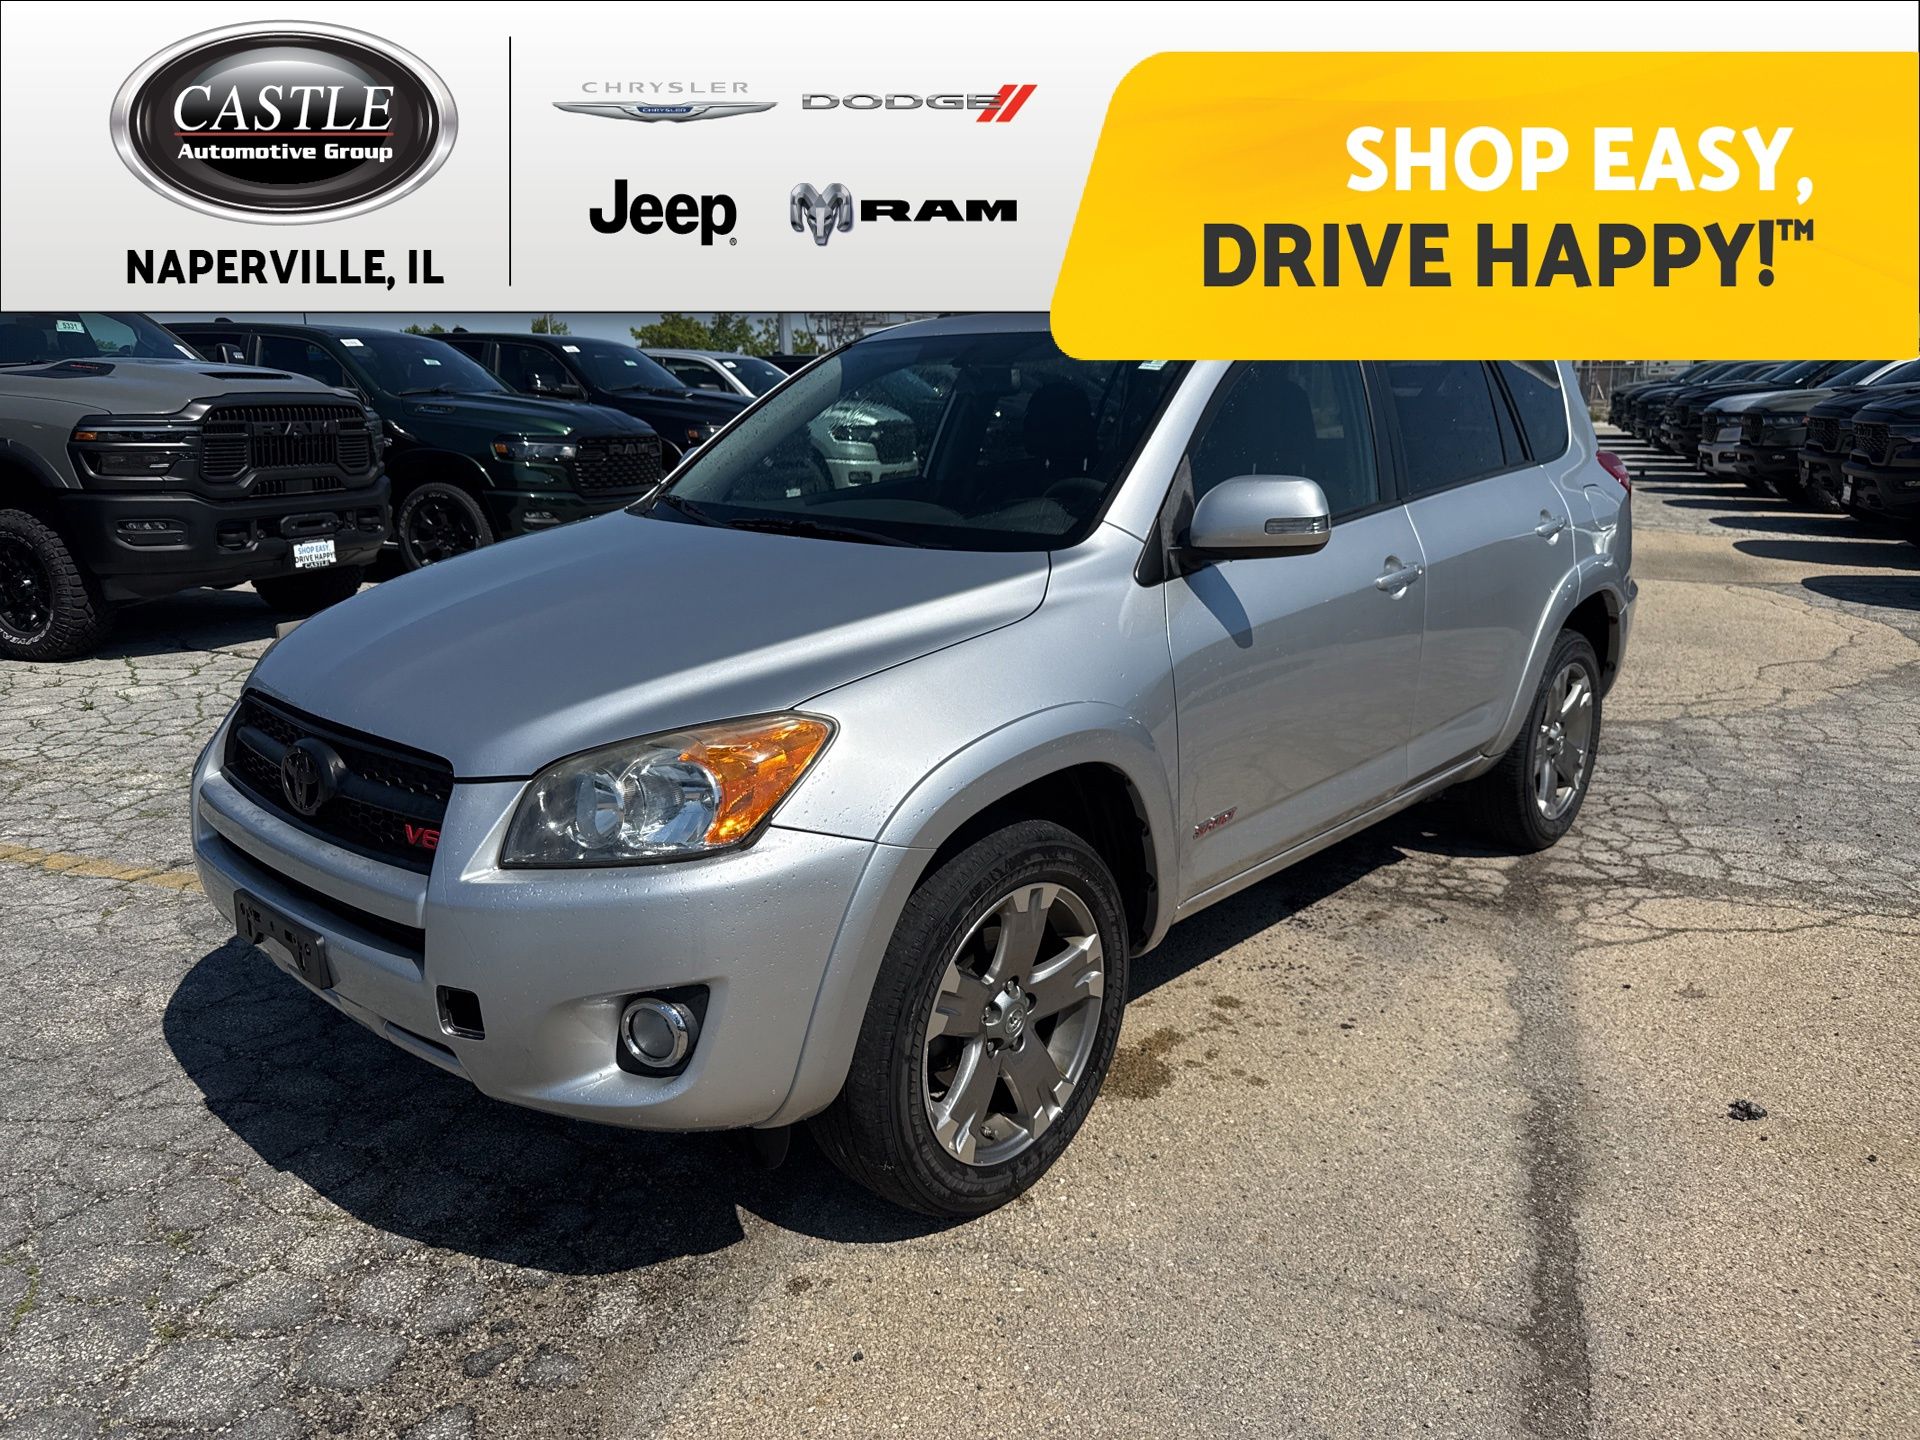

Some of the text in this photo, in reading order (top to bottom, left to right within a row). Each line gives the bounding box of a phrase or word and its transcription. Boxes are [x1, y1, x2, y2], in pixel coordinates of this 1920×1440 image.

[608, 442, 650, 456] RAM
[298, 546, 315, 555] SHOP
[295, 554, 314, 563] DRIVE
[404, 823, 440, 849] V6
